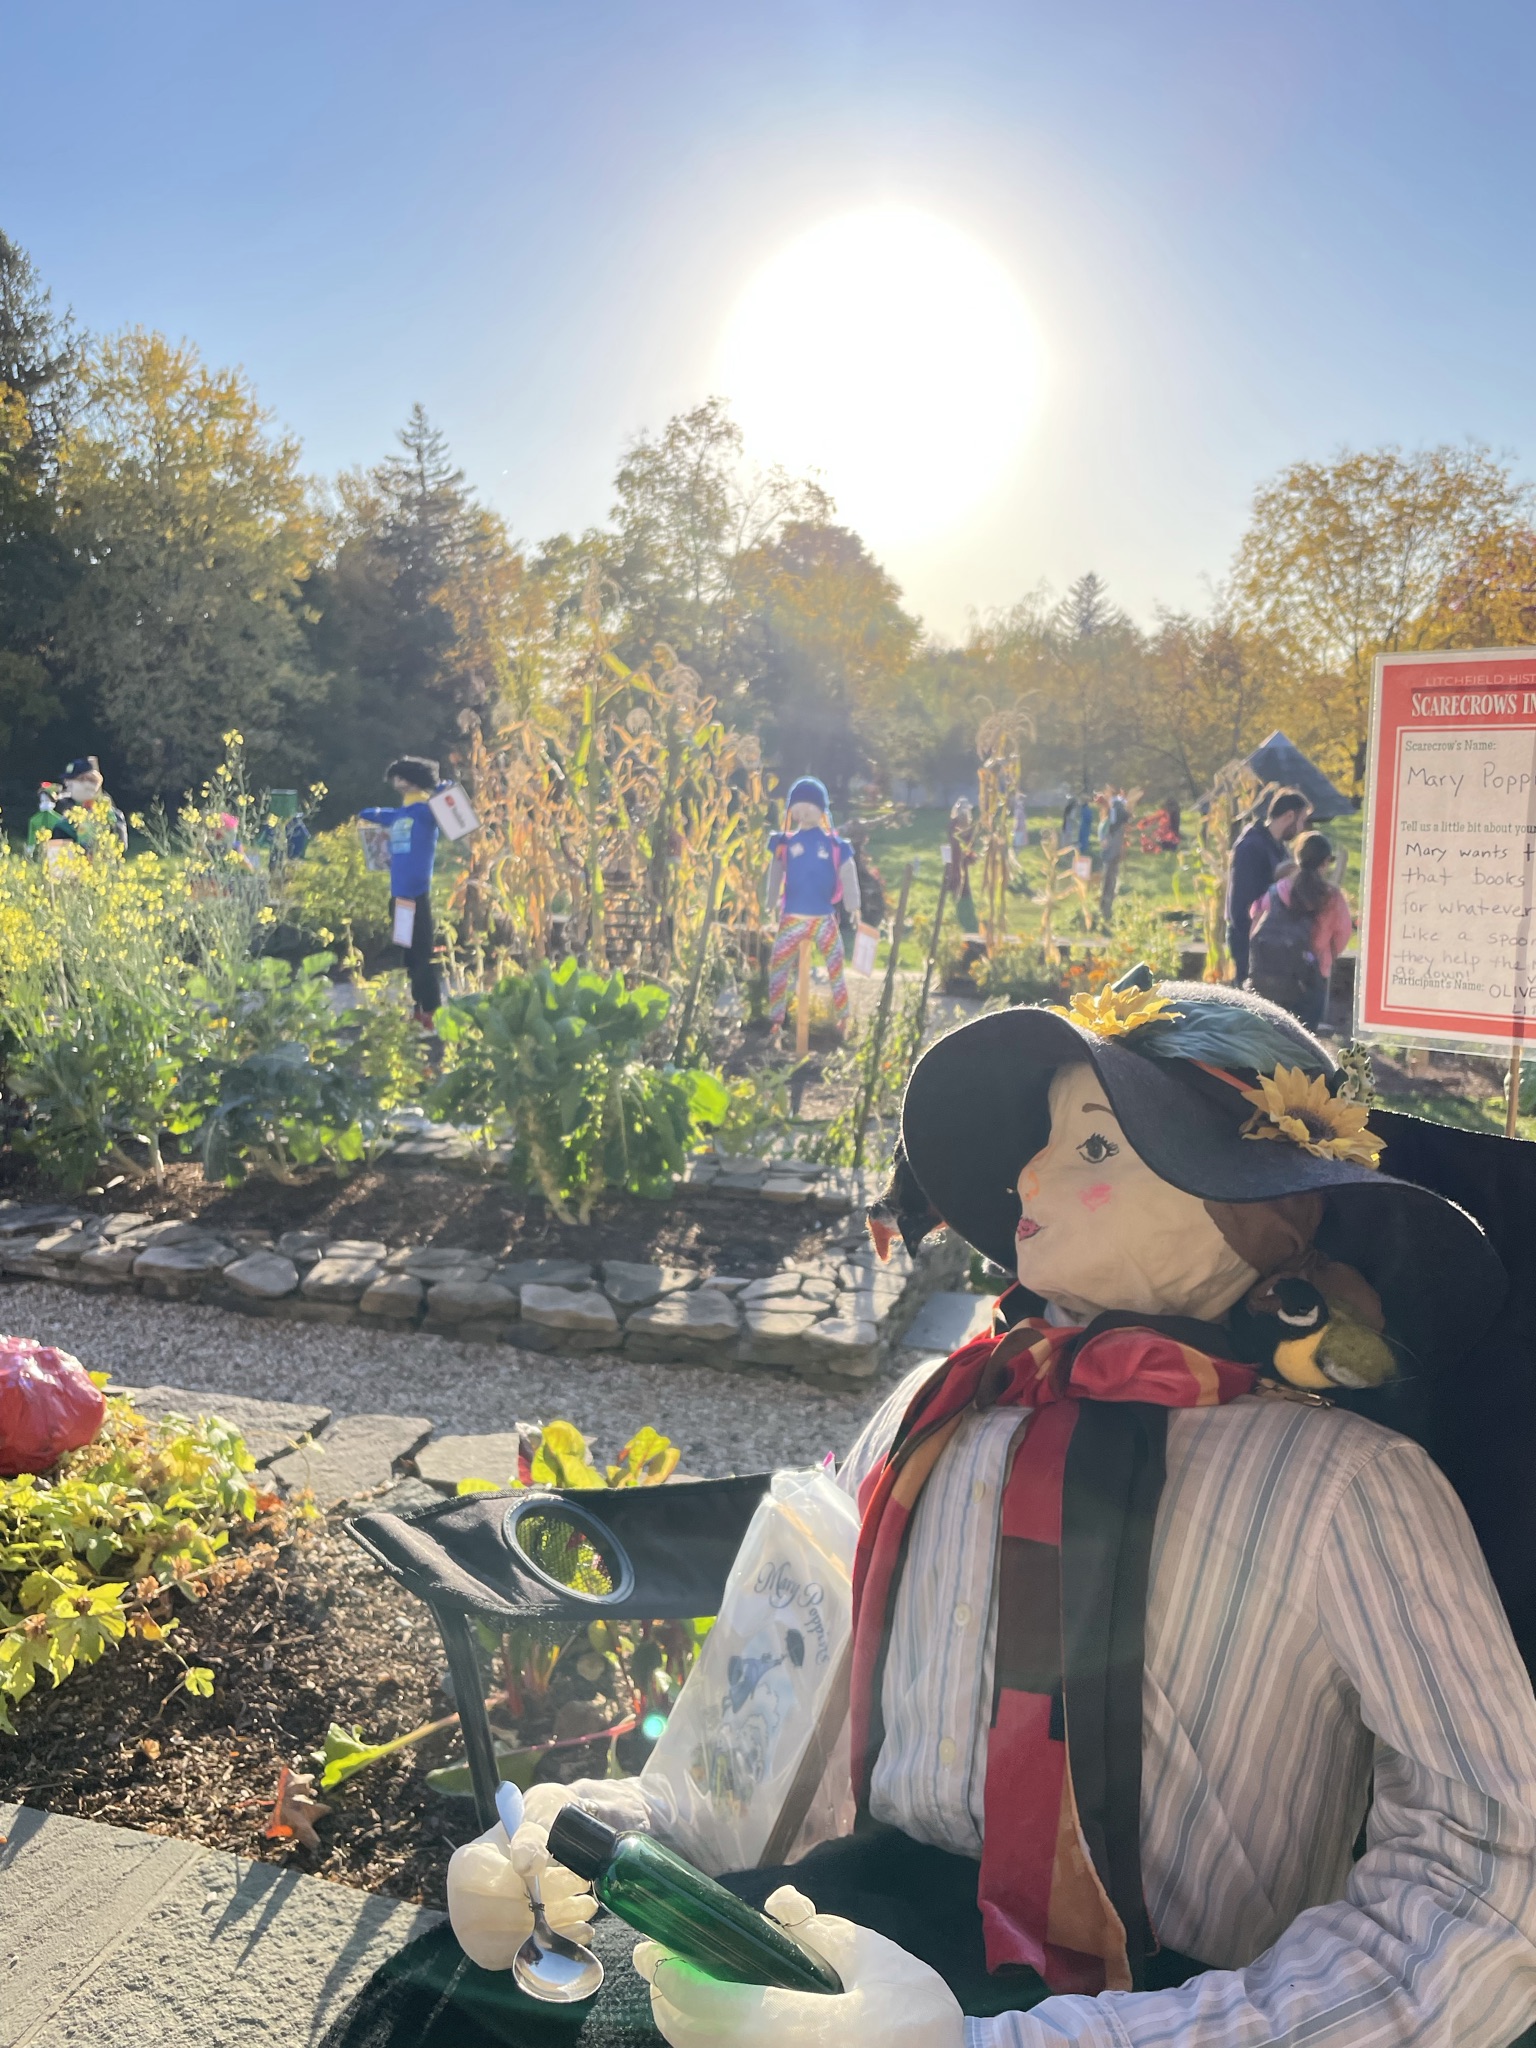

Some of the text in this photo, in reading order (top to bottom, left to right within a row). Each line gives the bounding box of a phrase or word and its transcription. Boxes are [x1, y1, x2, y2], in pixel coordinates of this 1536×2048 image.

[1425, 674, 1504, 687] LITCHFIELD
[1411, 693, 1517, 717] SCARECROWS
[1405, 740, 1496, 751] Scarecrow's Name:
[1407, 766, 1464, 797] Mary
[1401, 820, 1418, 832] Tell
[1420, 822, 1431, 832] us
[1433, 824, 1439, 832] a
[1441, 820, 1465, 833] little
[1467, 821, 1482, 833] bit
[1484, 822, 1512, 834] about
[1405, 843, 1447, 862] Mary
[1459, 844, 1508, 860] wants
[1401, 867, 1526, 887] that books
[1402, 891, 1536, 917] for whatever
[1457, 931, 1472, 941] a
[1393, 950, 1434, 969] they
[1443, 950, 1481, 974] help
[1489, 957, 1526, 971] the
[1395, 965, 1415, 979] go
[1392, 974, 1486, 992] Participant's Name:
[754, 1561, 831, 1666] Mary Poppins
